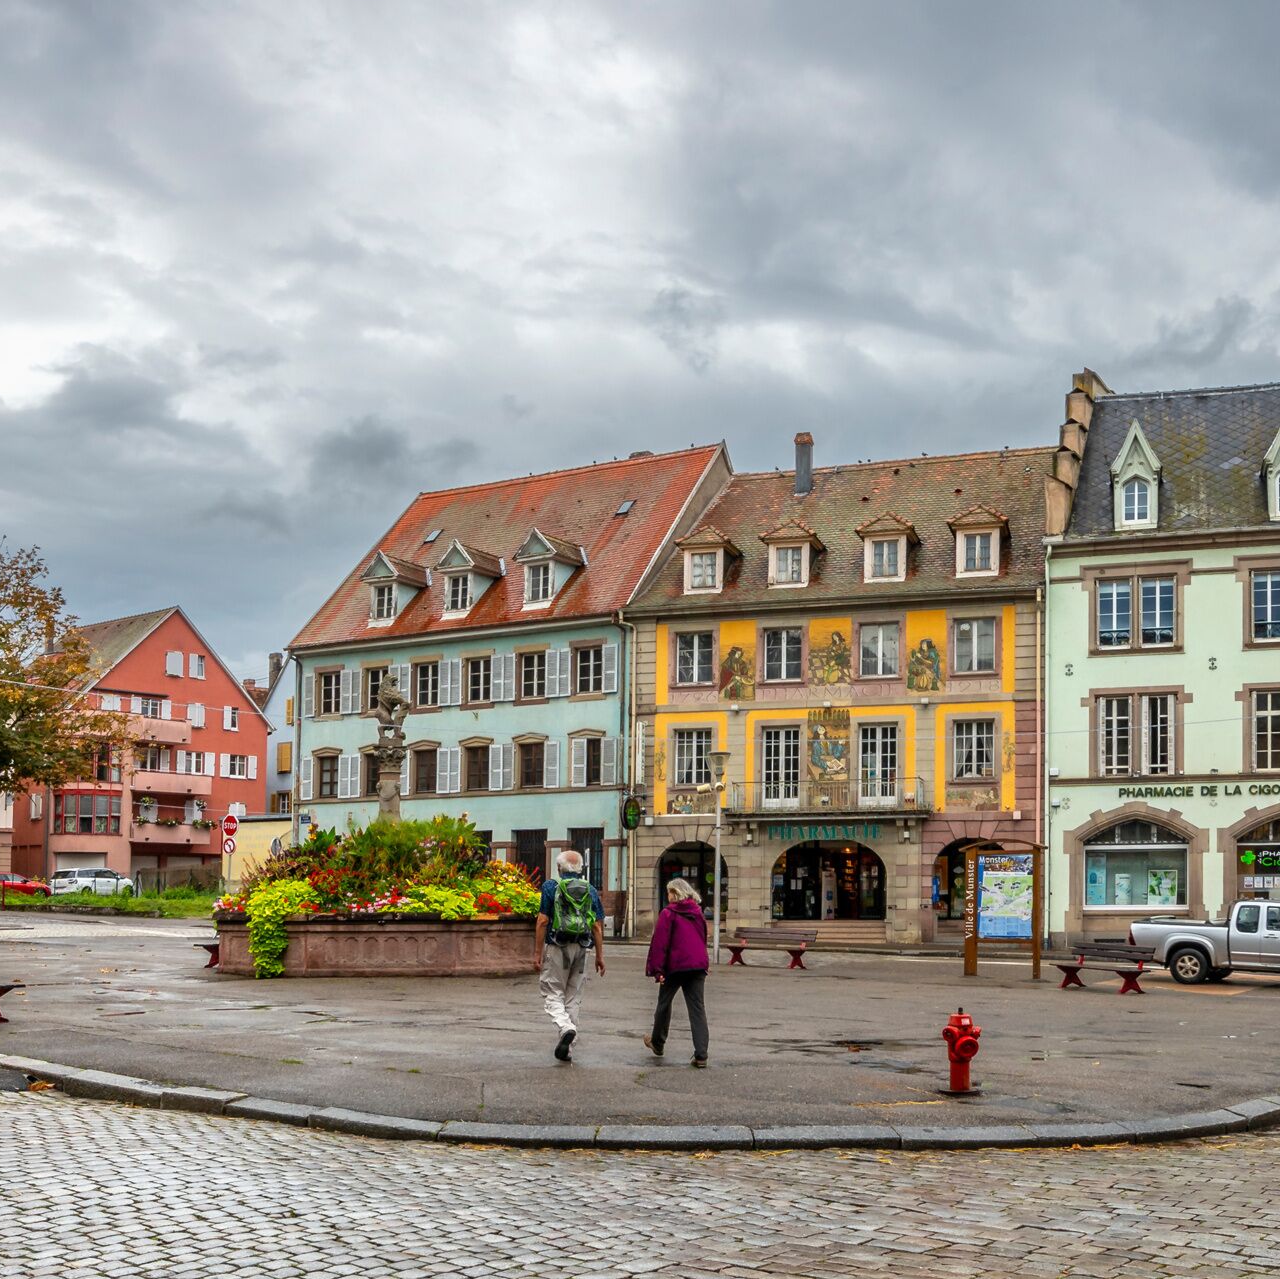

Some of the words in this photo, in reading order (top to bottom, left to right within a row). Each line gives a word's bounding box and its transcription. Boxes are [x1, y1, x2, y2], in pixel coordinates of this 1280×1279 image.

[1118, 786, 1194, 798] PHARMACIE
[1200, 785, 1218, 797] DE
[1224, 785, 1242, 796] LA
[767, 823, 882, 840] PHARMACIE
[966, 860, 975, 900] Munster
[965, 903, 974, 914] de
[965, 917, 974, 938] Ville
